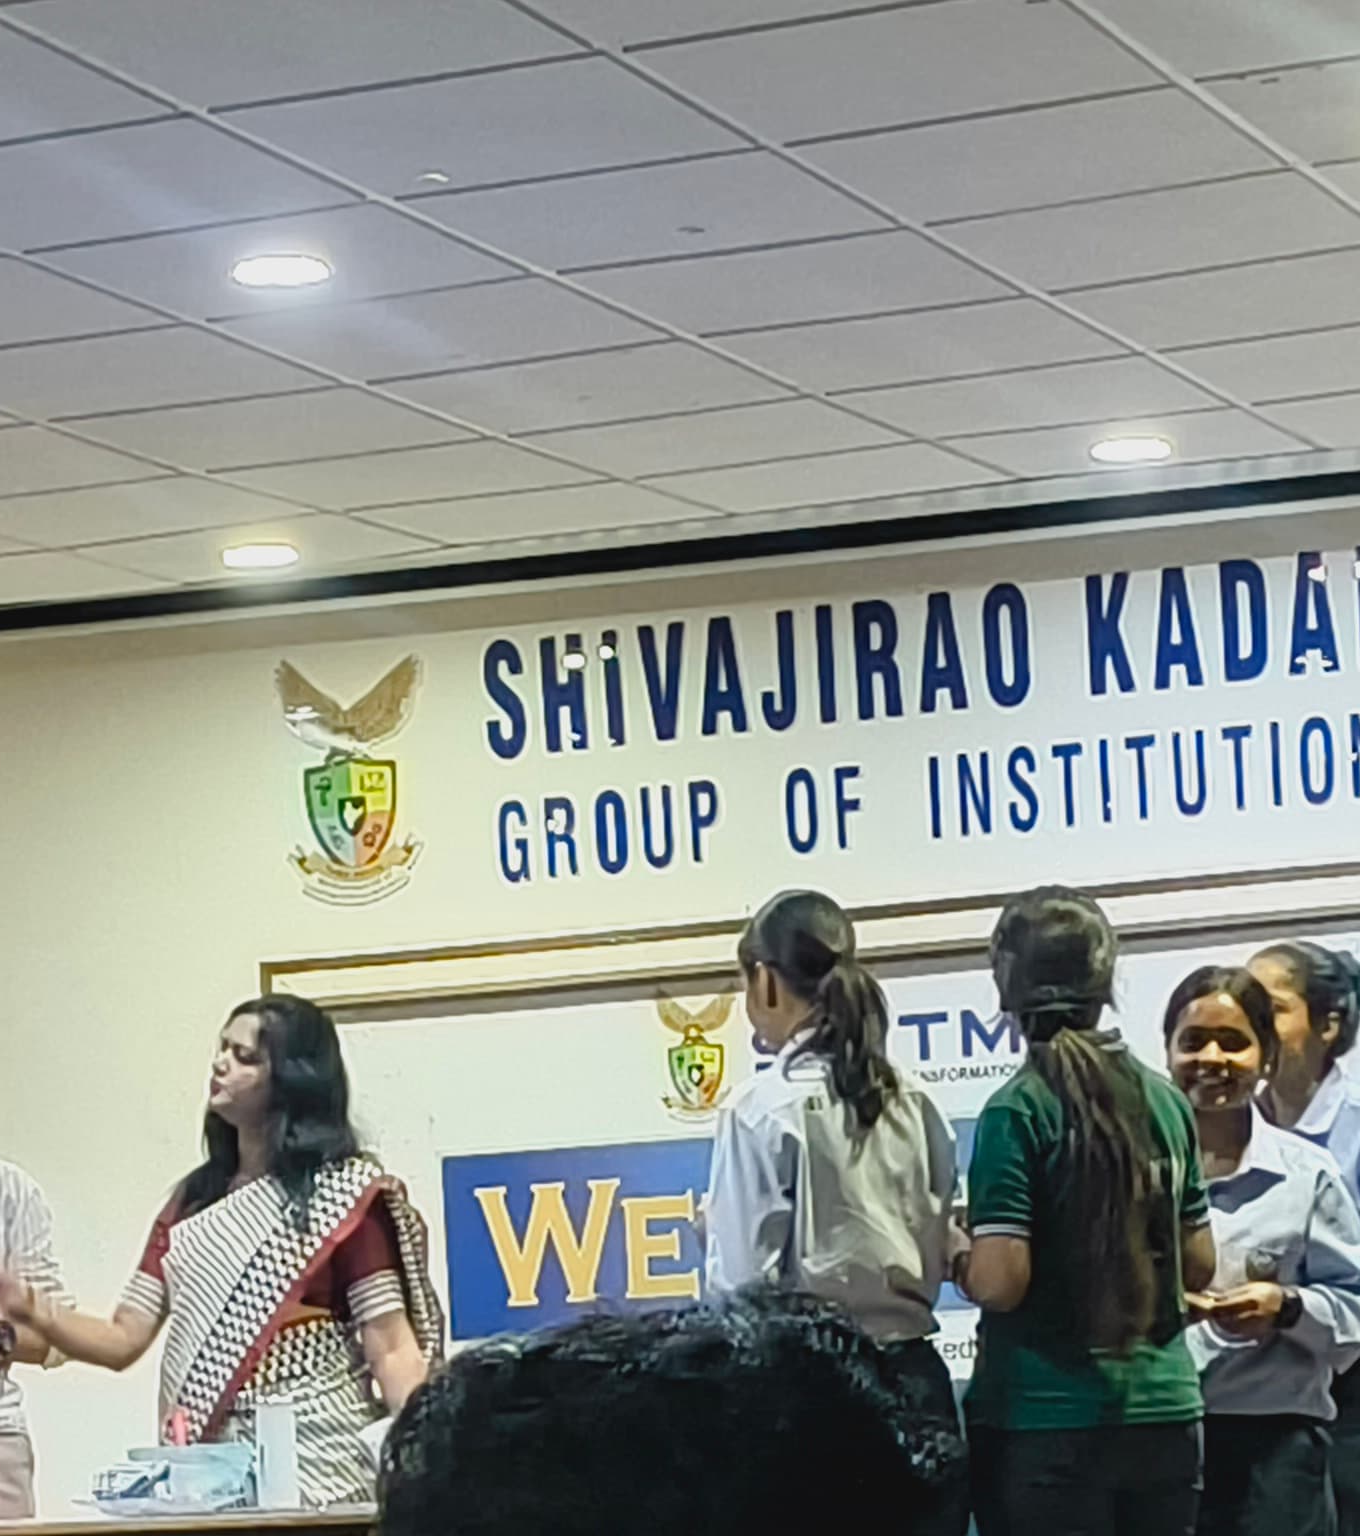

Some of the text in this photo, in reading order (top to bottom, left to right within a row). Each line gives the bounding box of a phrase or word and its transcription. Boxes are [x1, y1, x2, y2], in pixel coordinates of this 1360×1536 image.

[484, 582, 1031, 759] SHIVAJIRAO
[498, 778, 720, 882] GROUP
[785, 765, 862, 855] OF
